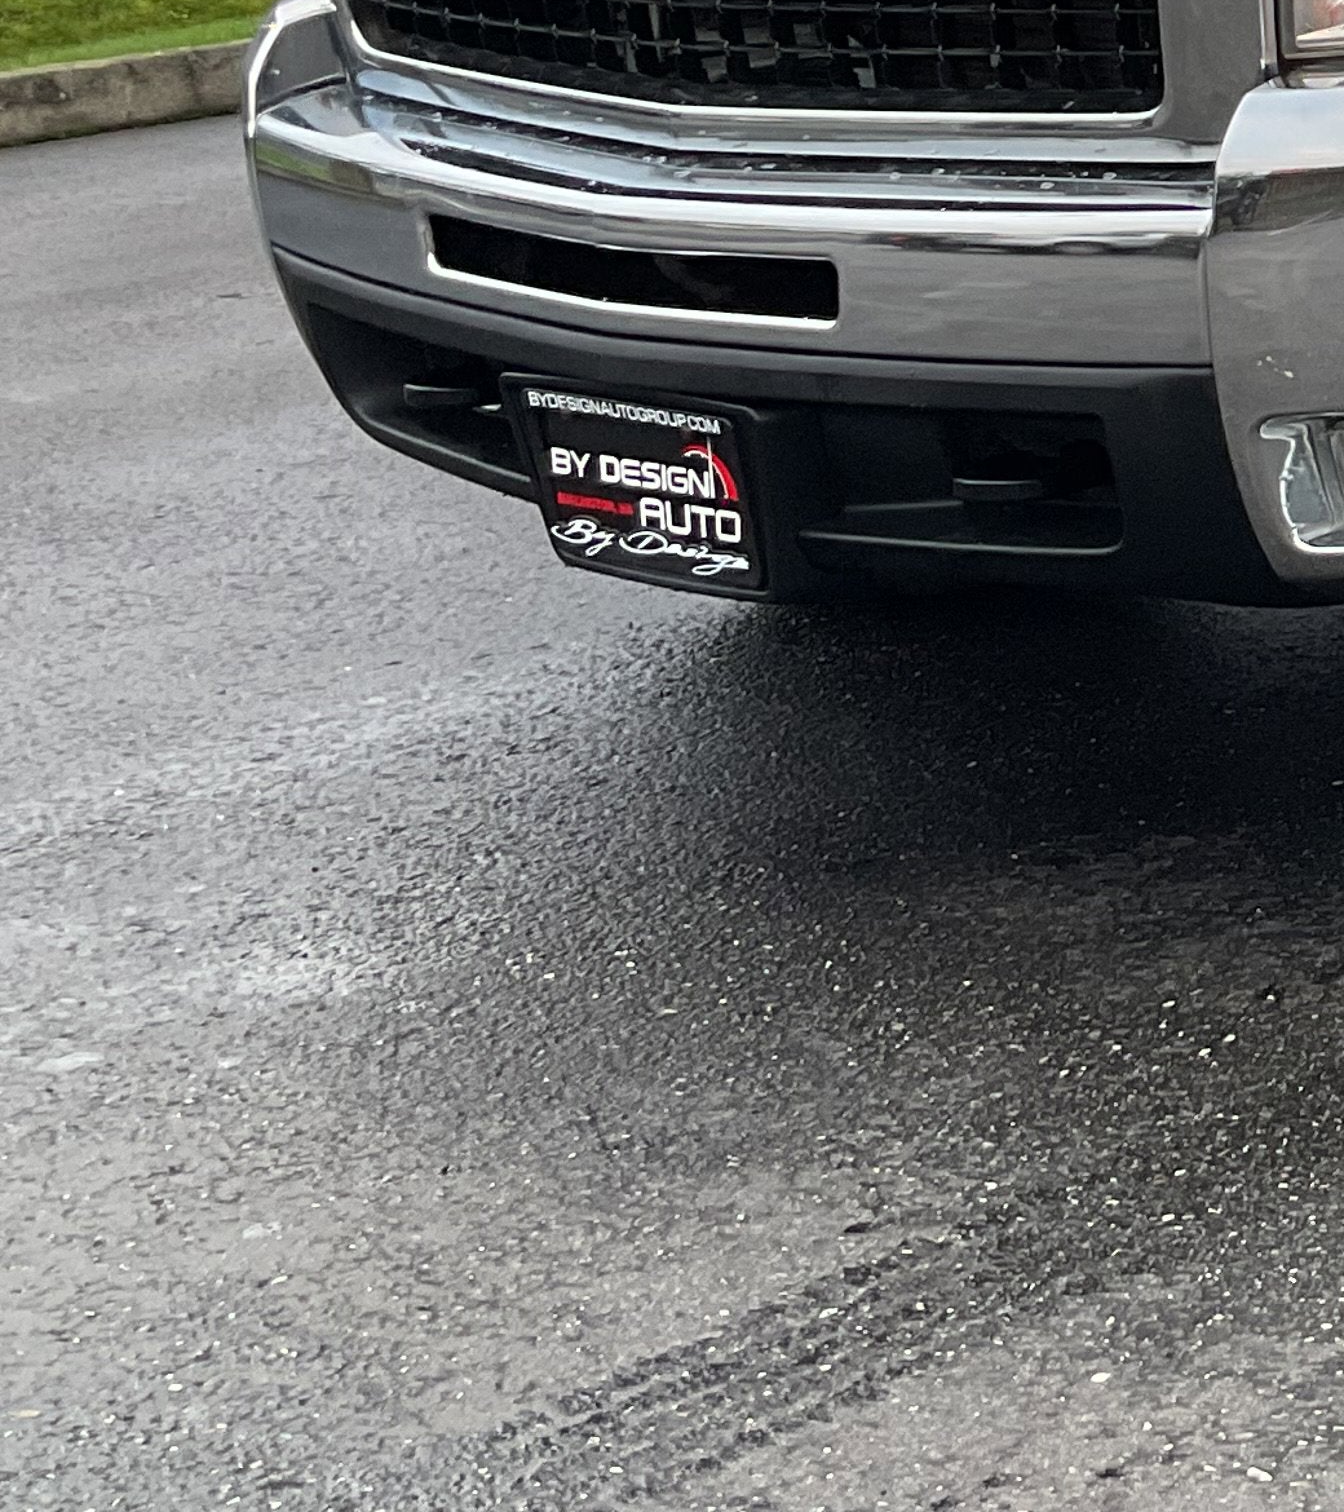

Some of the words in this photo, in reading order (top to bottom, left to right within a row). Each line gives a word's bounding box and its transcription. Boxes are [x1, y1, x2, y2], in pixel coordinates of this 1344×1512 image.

[550, 446, 590, 478] BY
[599, 454, 713, 500] DESIGN
[550, 518, 616, 557] By
[639, 497, 742, 544] AUTO
